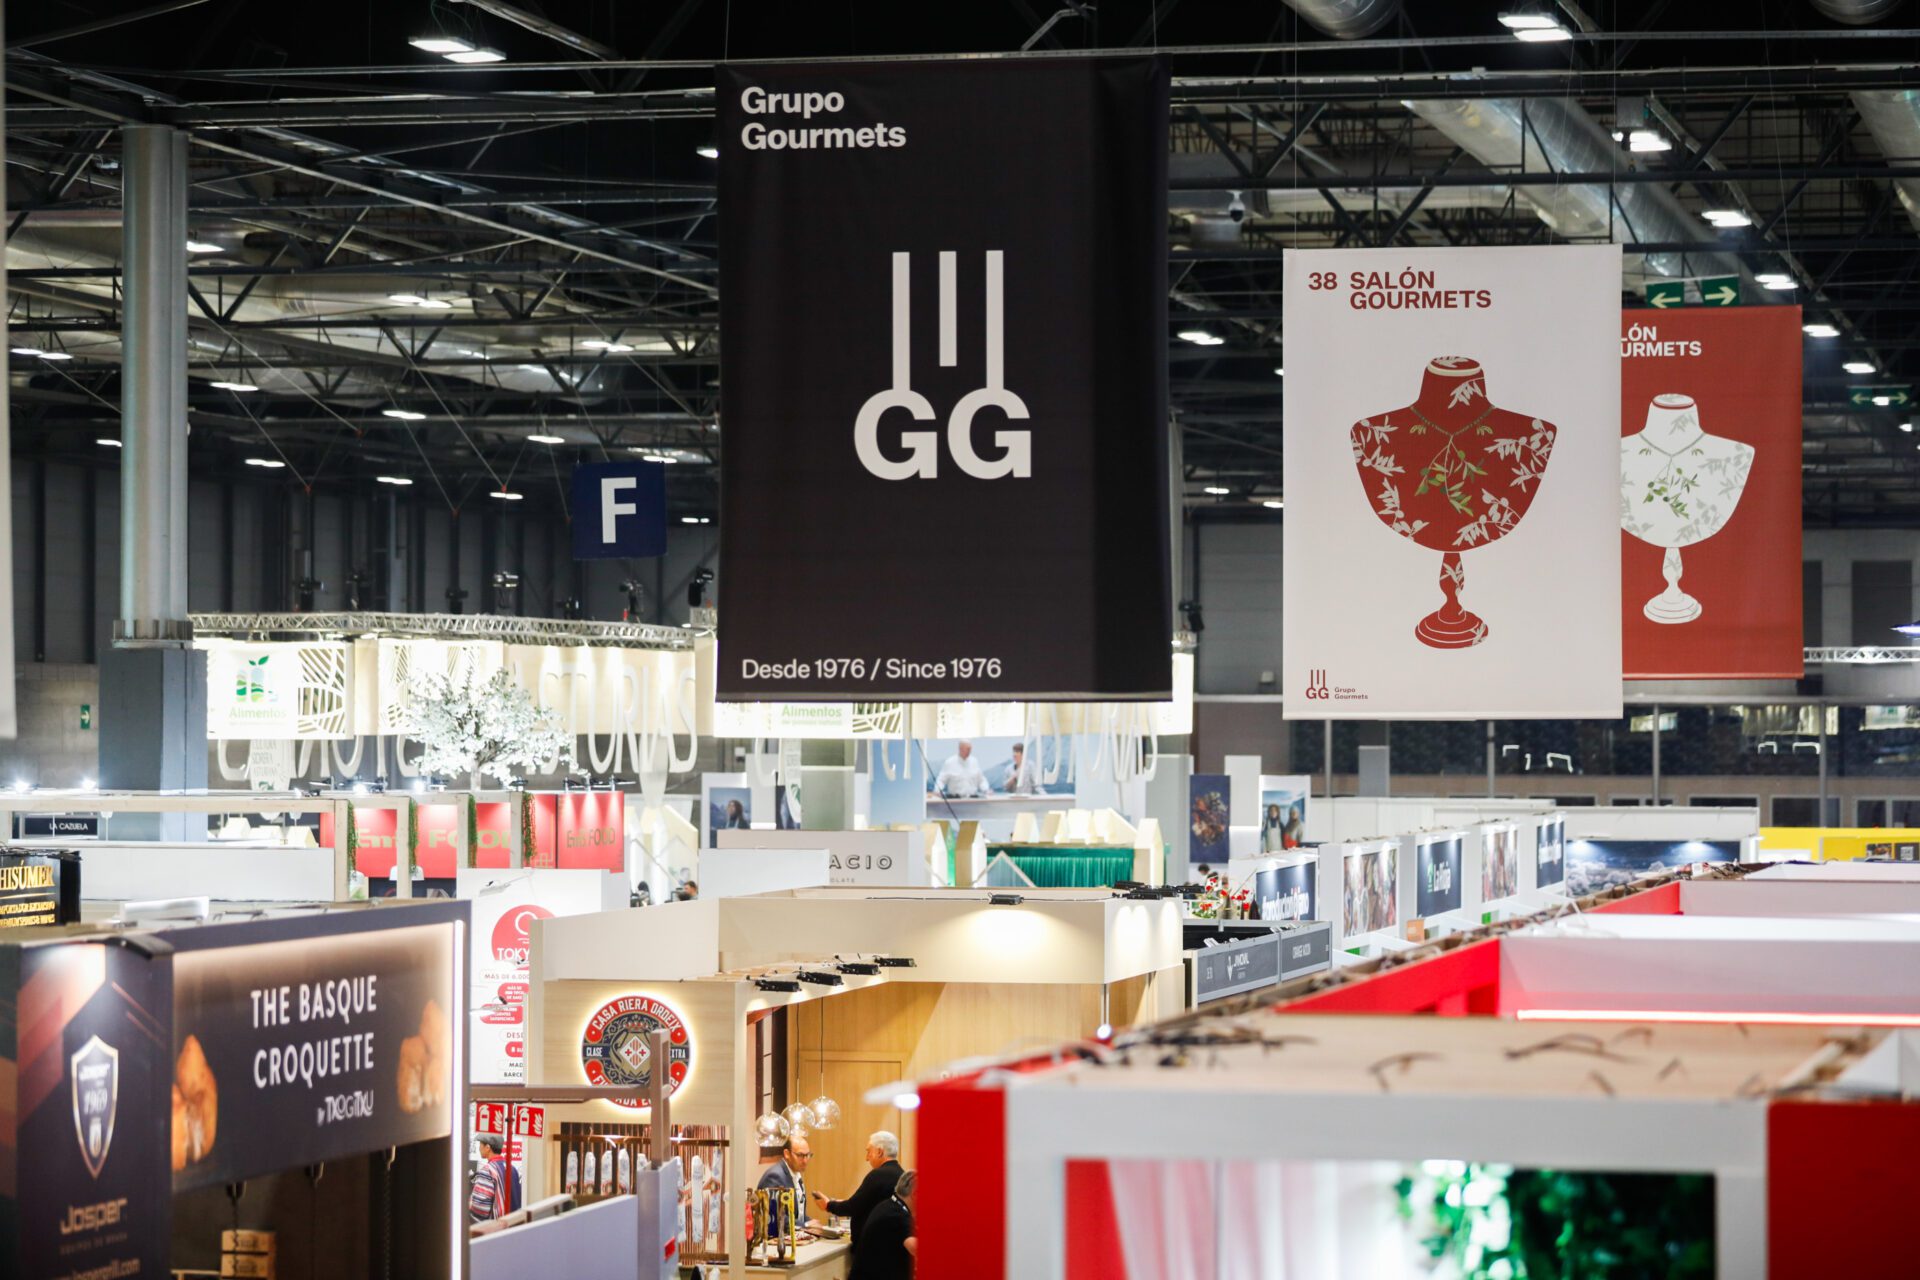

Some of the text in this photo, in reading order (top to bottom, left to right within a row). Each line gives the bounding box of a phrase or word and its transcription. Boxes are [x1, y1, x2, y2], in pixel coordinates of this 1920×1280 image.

[741, 86, 845, 119] Grupo
[741, 122, 907, 150] Gourmets
[1308, 266, 1435, 290] 38 SALÓN
[1350, 290, 1492, 309] GOURMETS
[1621, 340, 1702, 357] URMETS
[601, 477, 637, 544] F
[742, 658, 1003, 681] Desde 1976 / Since 1976
[229, 706, 287, 719] Alimentos
[781, 703, 843, 718] Alimentos
[59, 822, 89, 830] CAZUELA
[829, 855, 893, 870] ACIO
[250, 974, 378, 1029] THE BASQUE
[592, 998, 681, 1032] CASA RIERA ORDEIX
[253, 1032, 374, 1089] CROQUETTE
[586, 1047, 686, 1059] CLASE XTRA
[60, 1198, 128, 1235] Josper
